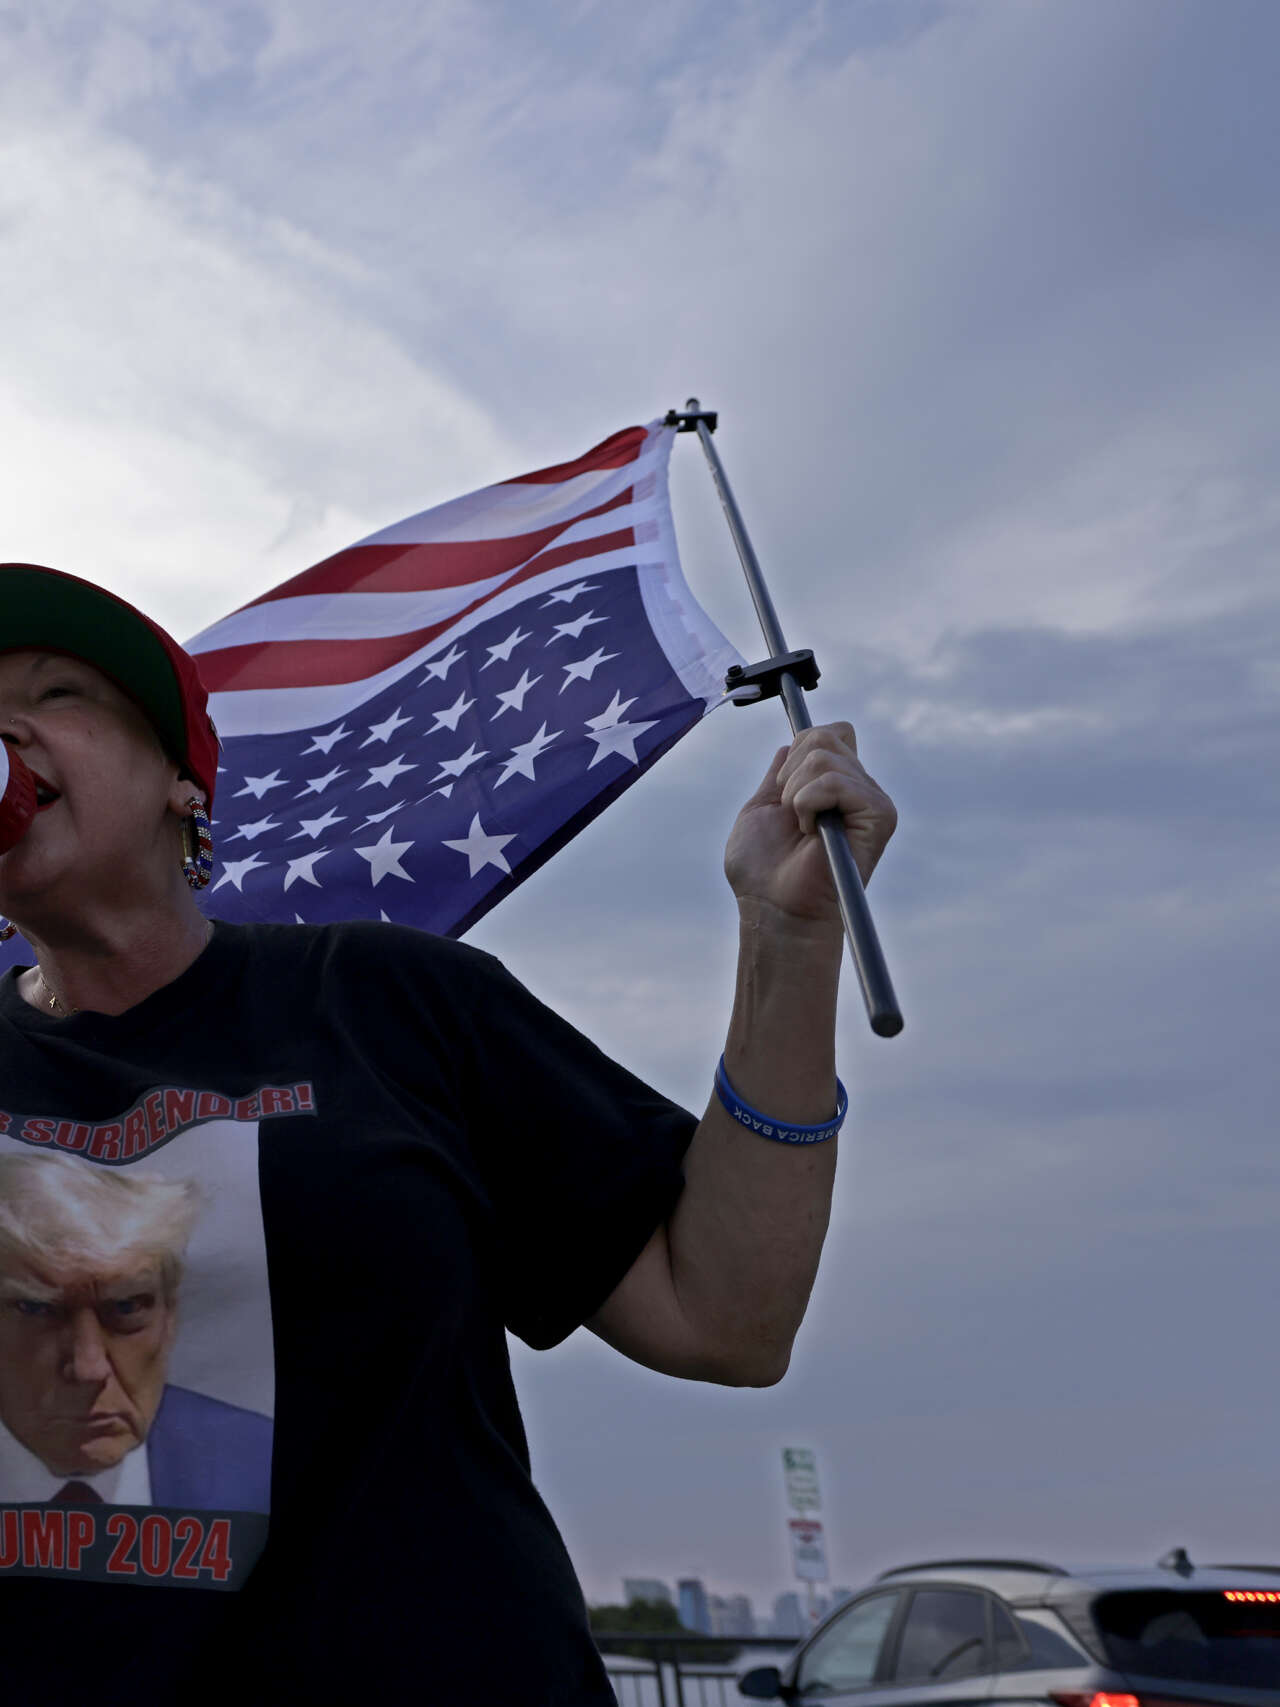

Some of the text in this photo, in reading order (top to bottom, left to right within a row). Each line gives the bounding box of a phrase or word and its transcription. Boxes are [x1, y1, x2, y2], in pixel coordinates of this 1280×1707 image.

[21, 1083, 313, 1160] SURRENDER!
[734, 1105, 837, 1142] MERICA BACK
[106, 1513, 231, 1581] 2024
